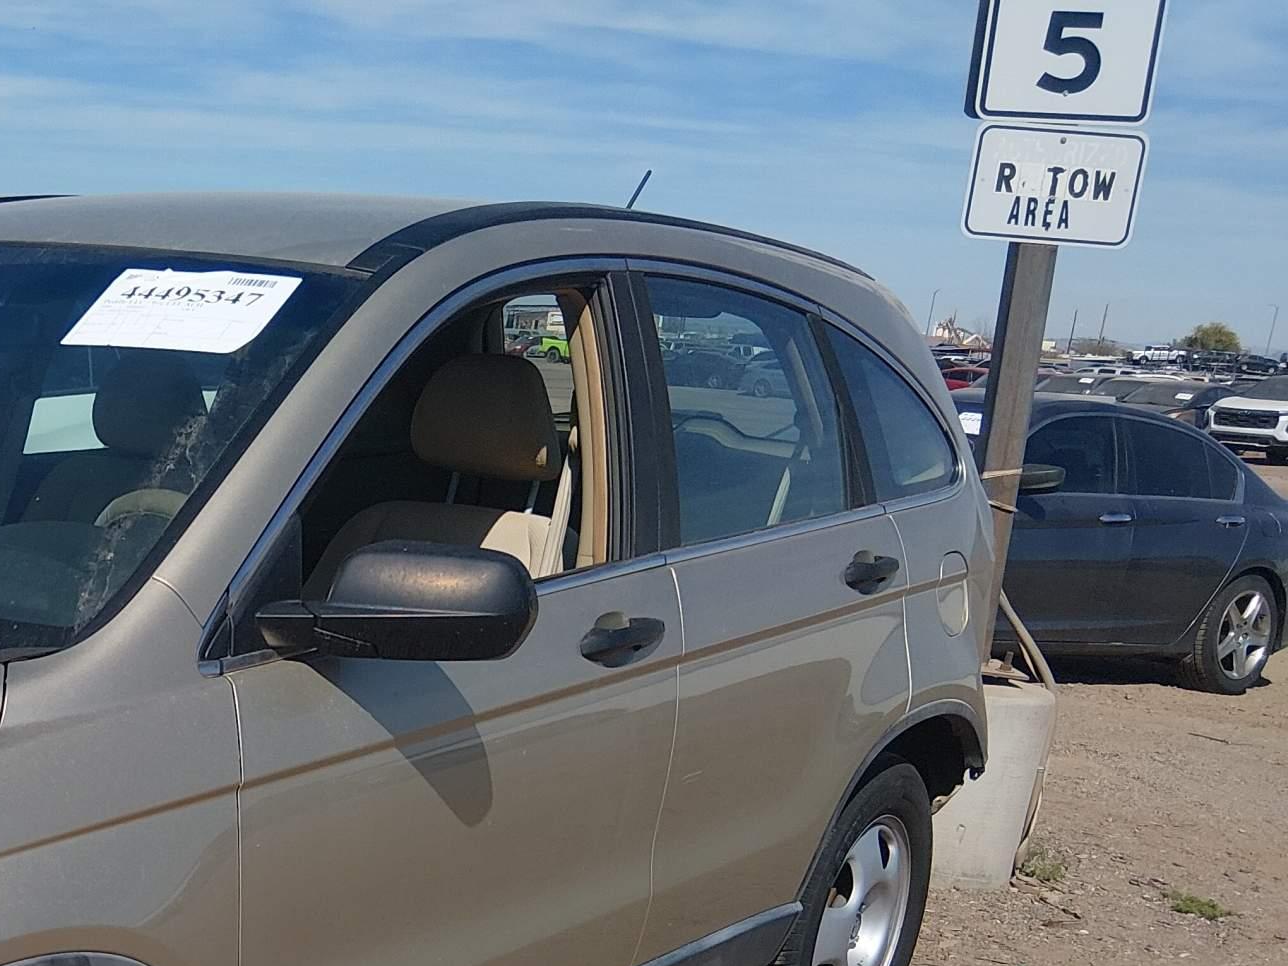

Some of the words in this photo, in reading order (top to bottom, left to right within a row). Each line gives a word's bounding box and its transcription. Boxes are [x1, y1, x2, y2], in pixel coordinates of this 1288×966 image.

[1035, 11, 1104, 95] 5
[1047, 166, 1116, 201] TOW
[1007, 195, 1070, 231] AREA
[120, 285, 264, 307] 44495347
